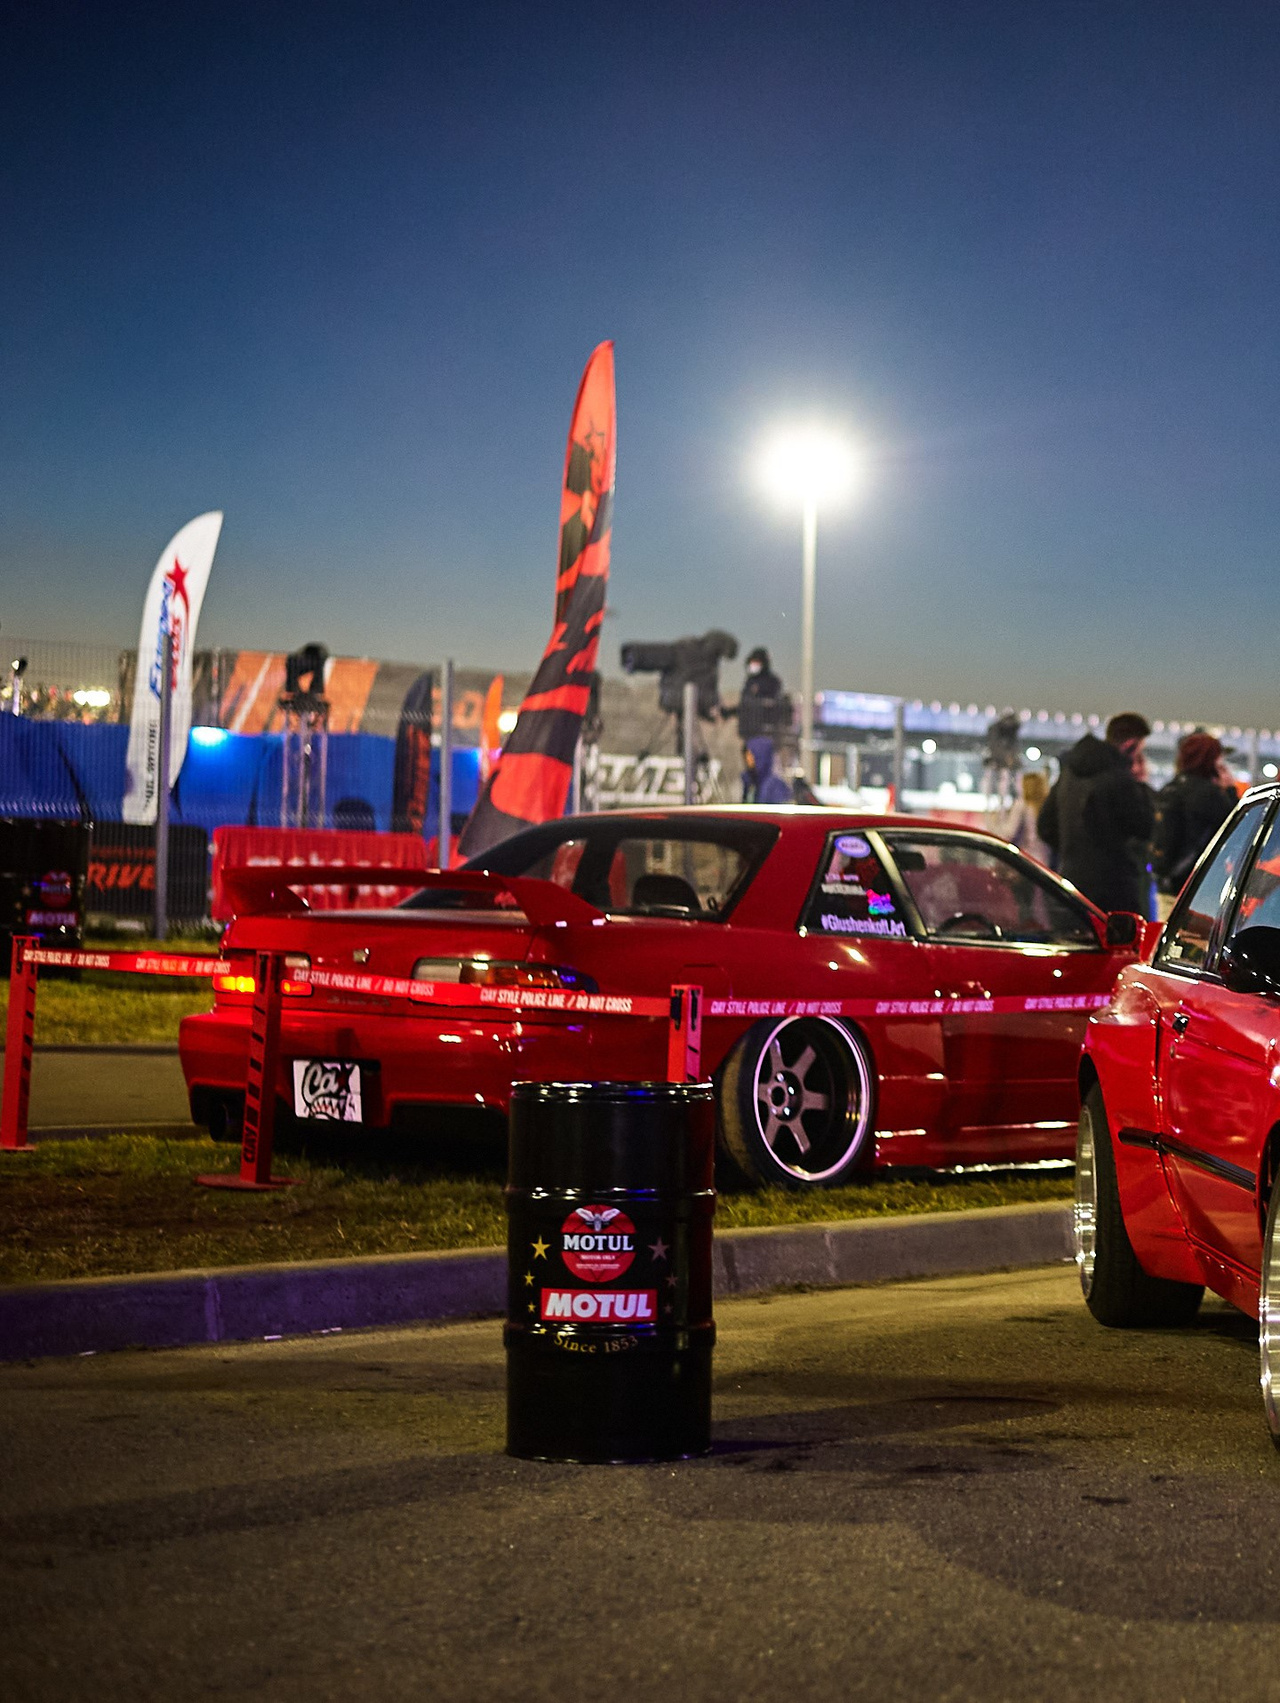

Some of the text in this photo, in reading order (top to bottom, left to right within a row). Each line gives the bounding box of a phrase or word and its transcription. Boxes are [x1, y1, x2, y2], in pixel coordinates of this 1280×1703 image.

[310, 970, 330, 986] STYLE
[331, 973, 356, 988] POLICE
[356, 976, 372, 990] LINE
[383, 979, 395, 992] DO
[411, 983, 435, 997] CROSS
[498, 989, 520, 1005] STYLE
[520, 991, 548, 1007] POLICE
[547, 994, 565, 1008] LINE
[576, 994, 589, 1010] DO
[589, 995, 606, 1011] NOT
[605, 997, 633, 1013] CROSS
[726, 1001, 746, 1014] STYLE
[747, 1001, 771, 1014] POLICE
[771, 1002, 786, 1014] LINE
[796, 1002, 807, 1014] DO
[820, 1001, 842, 1014] CROSS
[563, 1234, 634, 1251] MOTUL
[545, 1292, 653, 1318] MOTUL
[554, 1333, 639, 1353] Since 1853
